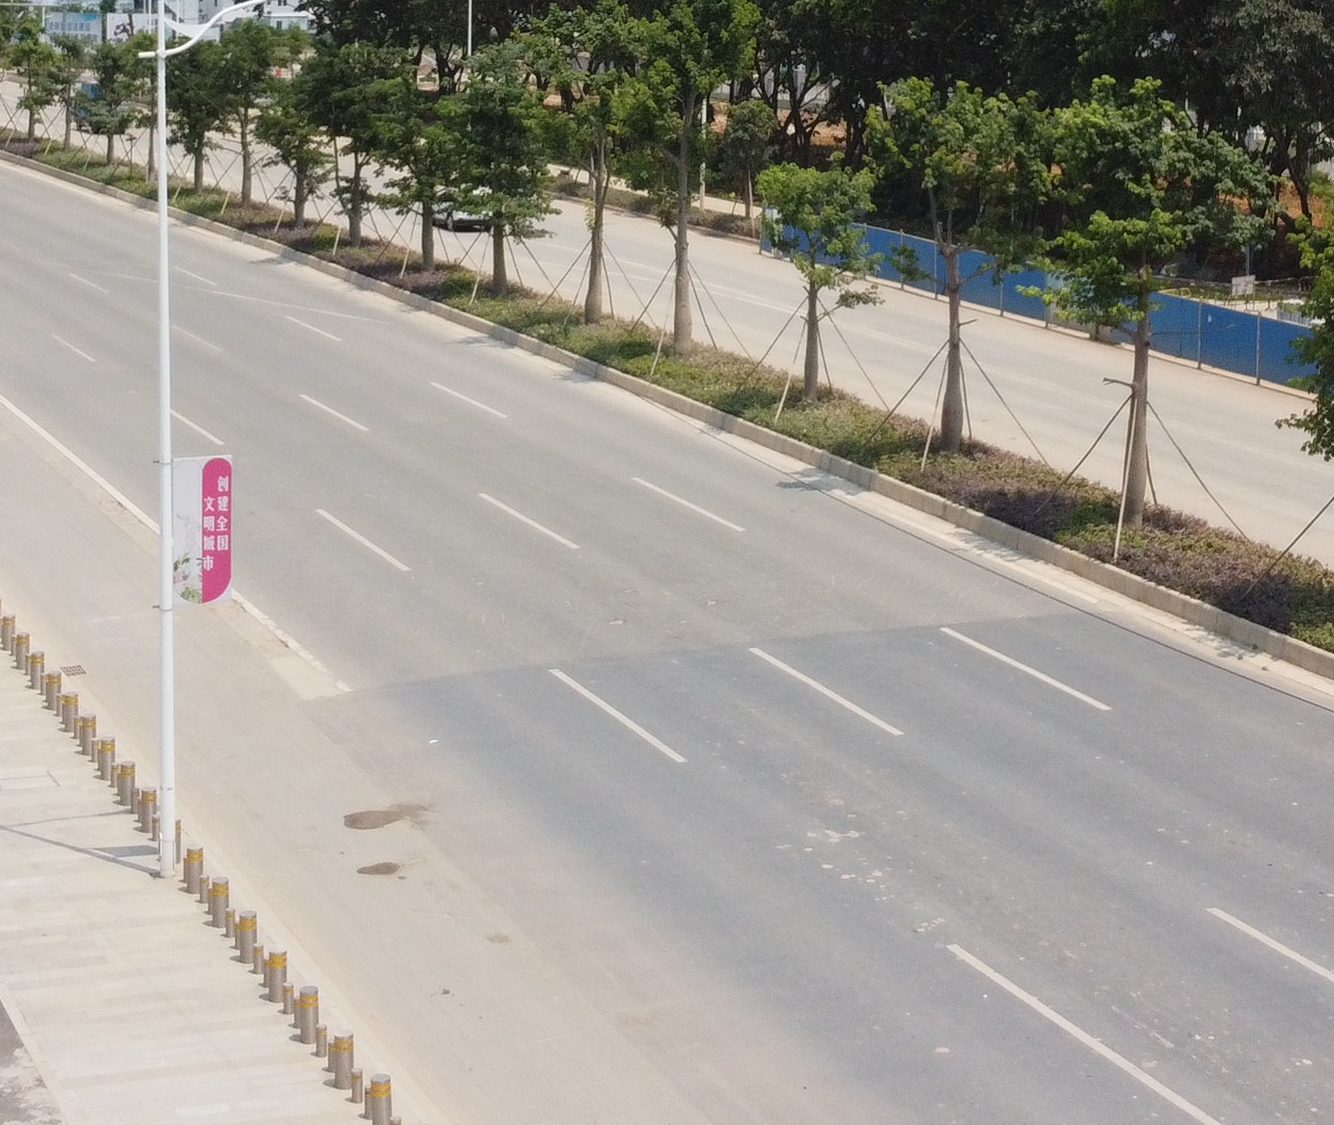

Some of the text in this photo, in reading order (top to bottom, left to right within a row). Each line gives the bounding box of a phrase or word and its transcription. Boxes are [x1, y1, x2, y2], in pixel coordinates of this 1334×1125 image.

[203, 496, 216, 571] 文明城市
[216, 476, 229, 551] 创建全国
